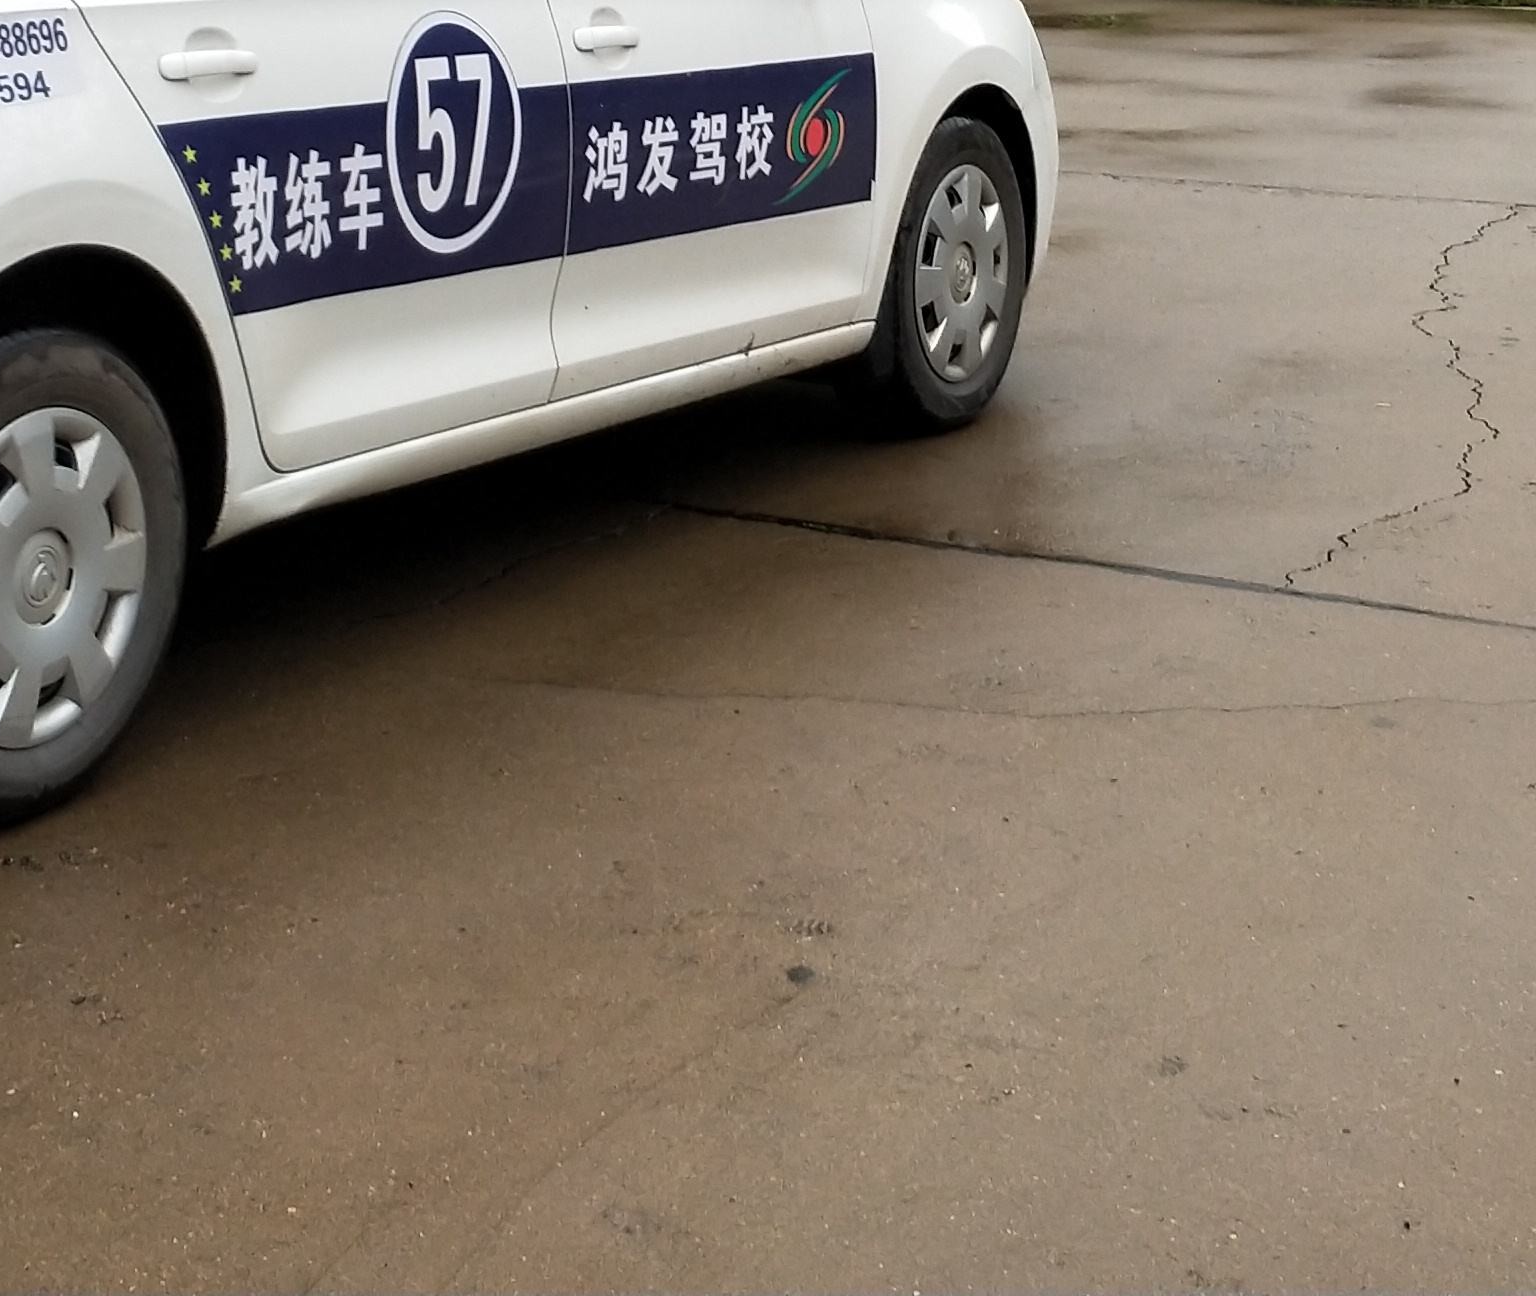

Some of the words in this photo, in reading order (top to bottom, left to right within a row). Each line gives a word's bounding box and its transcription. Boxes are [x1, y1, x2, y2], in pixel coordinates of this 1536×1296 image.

[230, 142, 384, 271] 教练车
[413, 52, 494, 214] 57
[582, 105, 775, 204] 鸿发驾校
